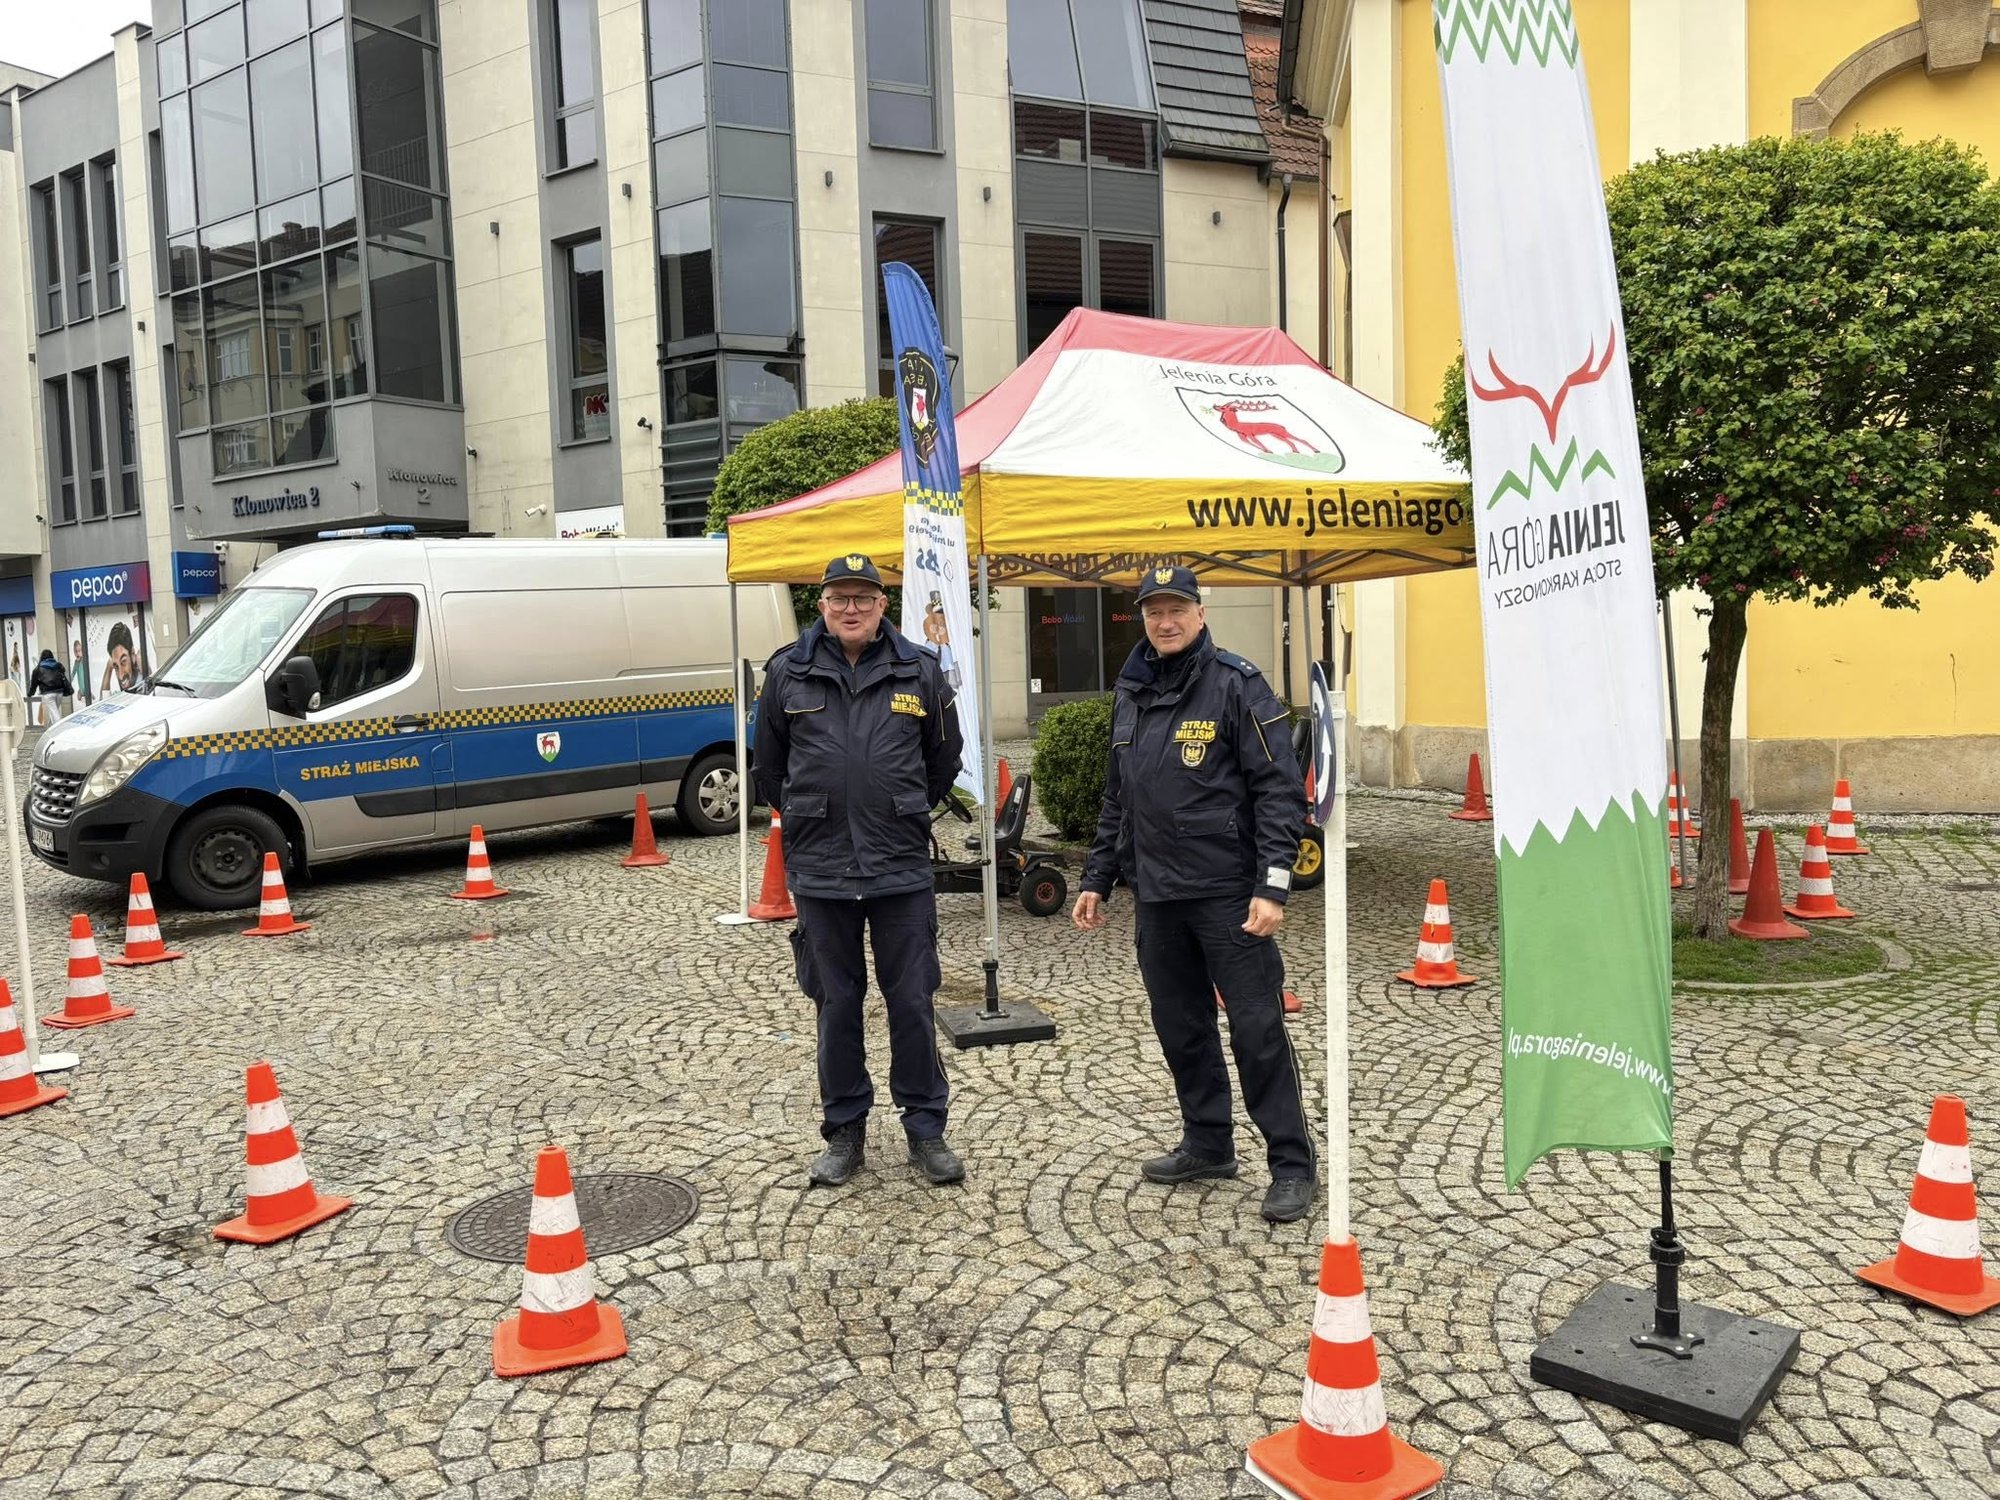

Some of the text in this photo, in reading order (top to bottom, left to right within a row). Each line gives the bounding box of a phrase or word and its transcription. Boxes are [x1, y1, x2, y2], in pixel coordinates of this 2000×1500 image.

[1160, 364, 1278, 387] Jelenia Góra
[232, 486, 320, 517] Klonowica 2
[416, 488, 431, 505] 2
[300, 756, 420, 781] STRAŻ MIEJSKA
